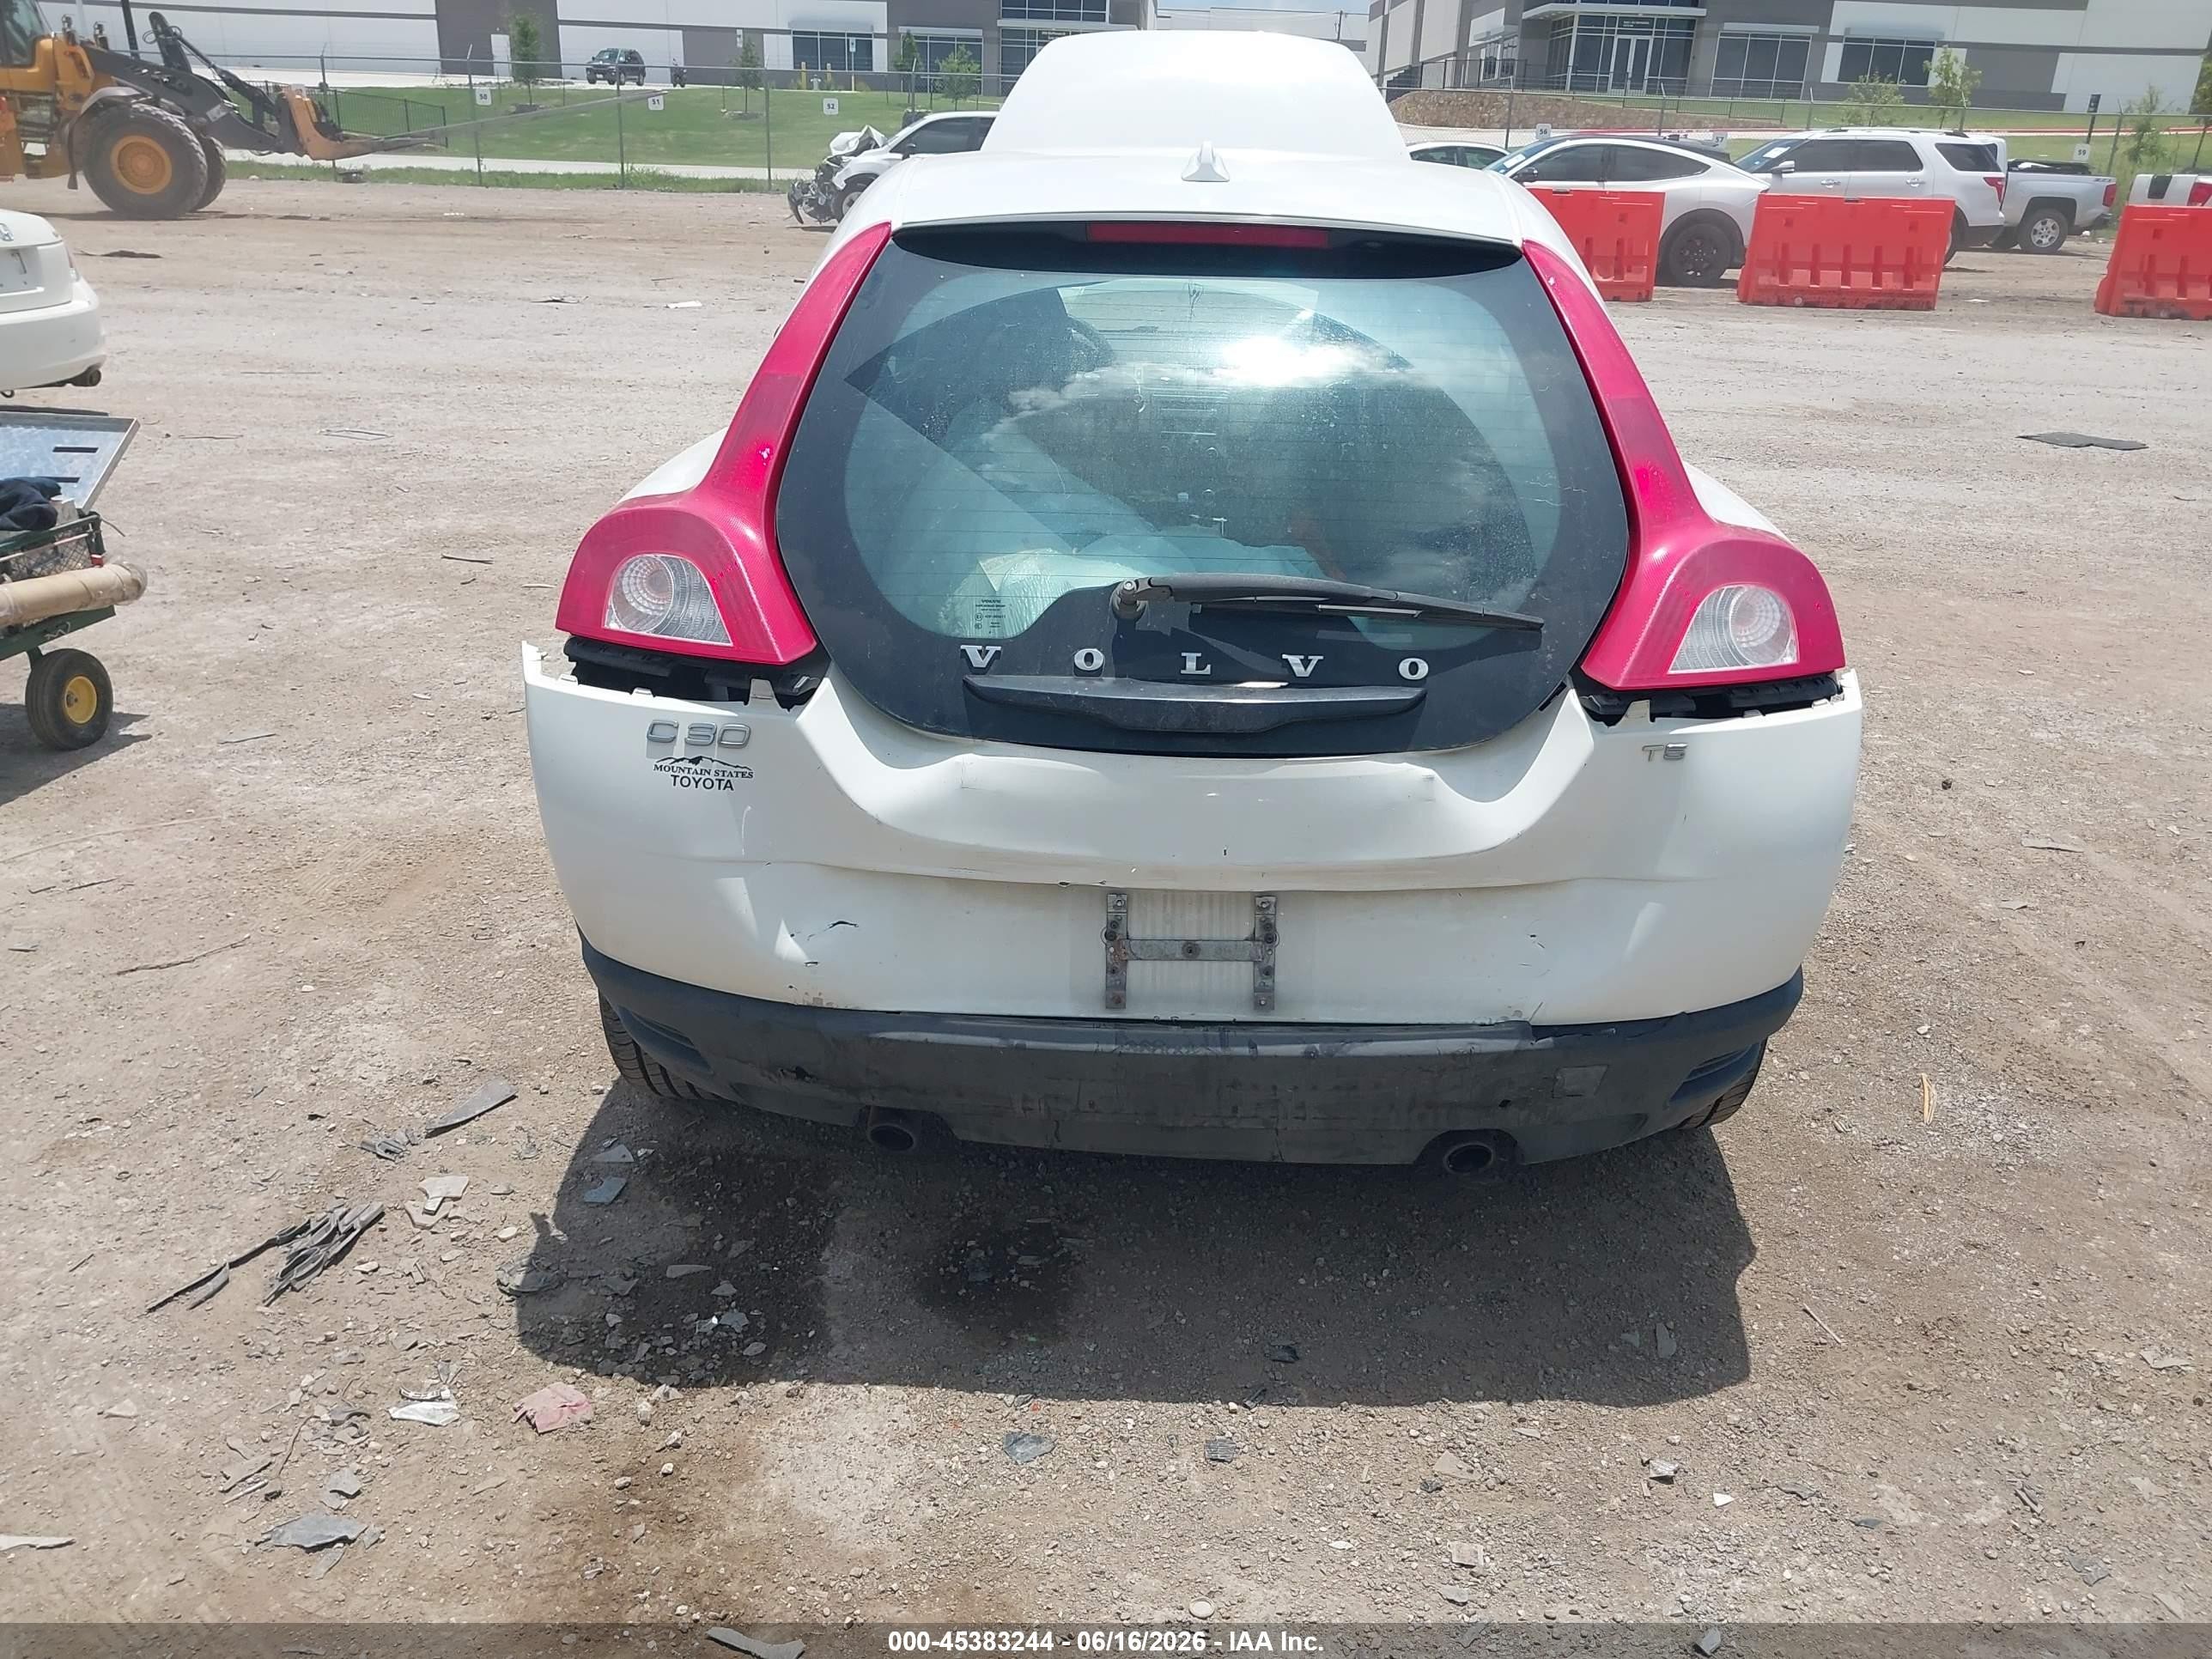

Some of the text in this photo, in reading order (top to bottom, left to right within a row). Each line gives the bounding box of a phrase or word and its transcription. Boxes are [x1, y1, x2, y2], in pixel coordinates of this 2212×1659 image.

[647, 720, 751, 749] C30
[653, 763, 754, 779] MOUNTAIN STATES
[671, 774, 734, 792] TOYOTA
